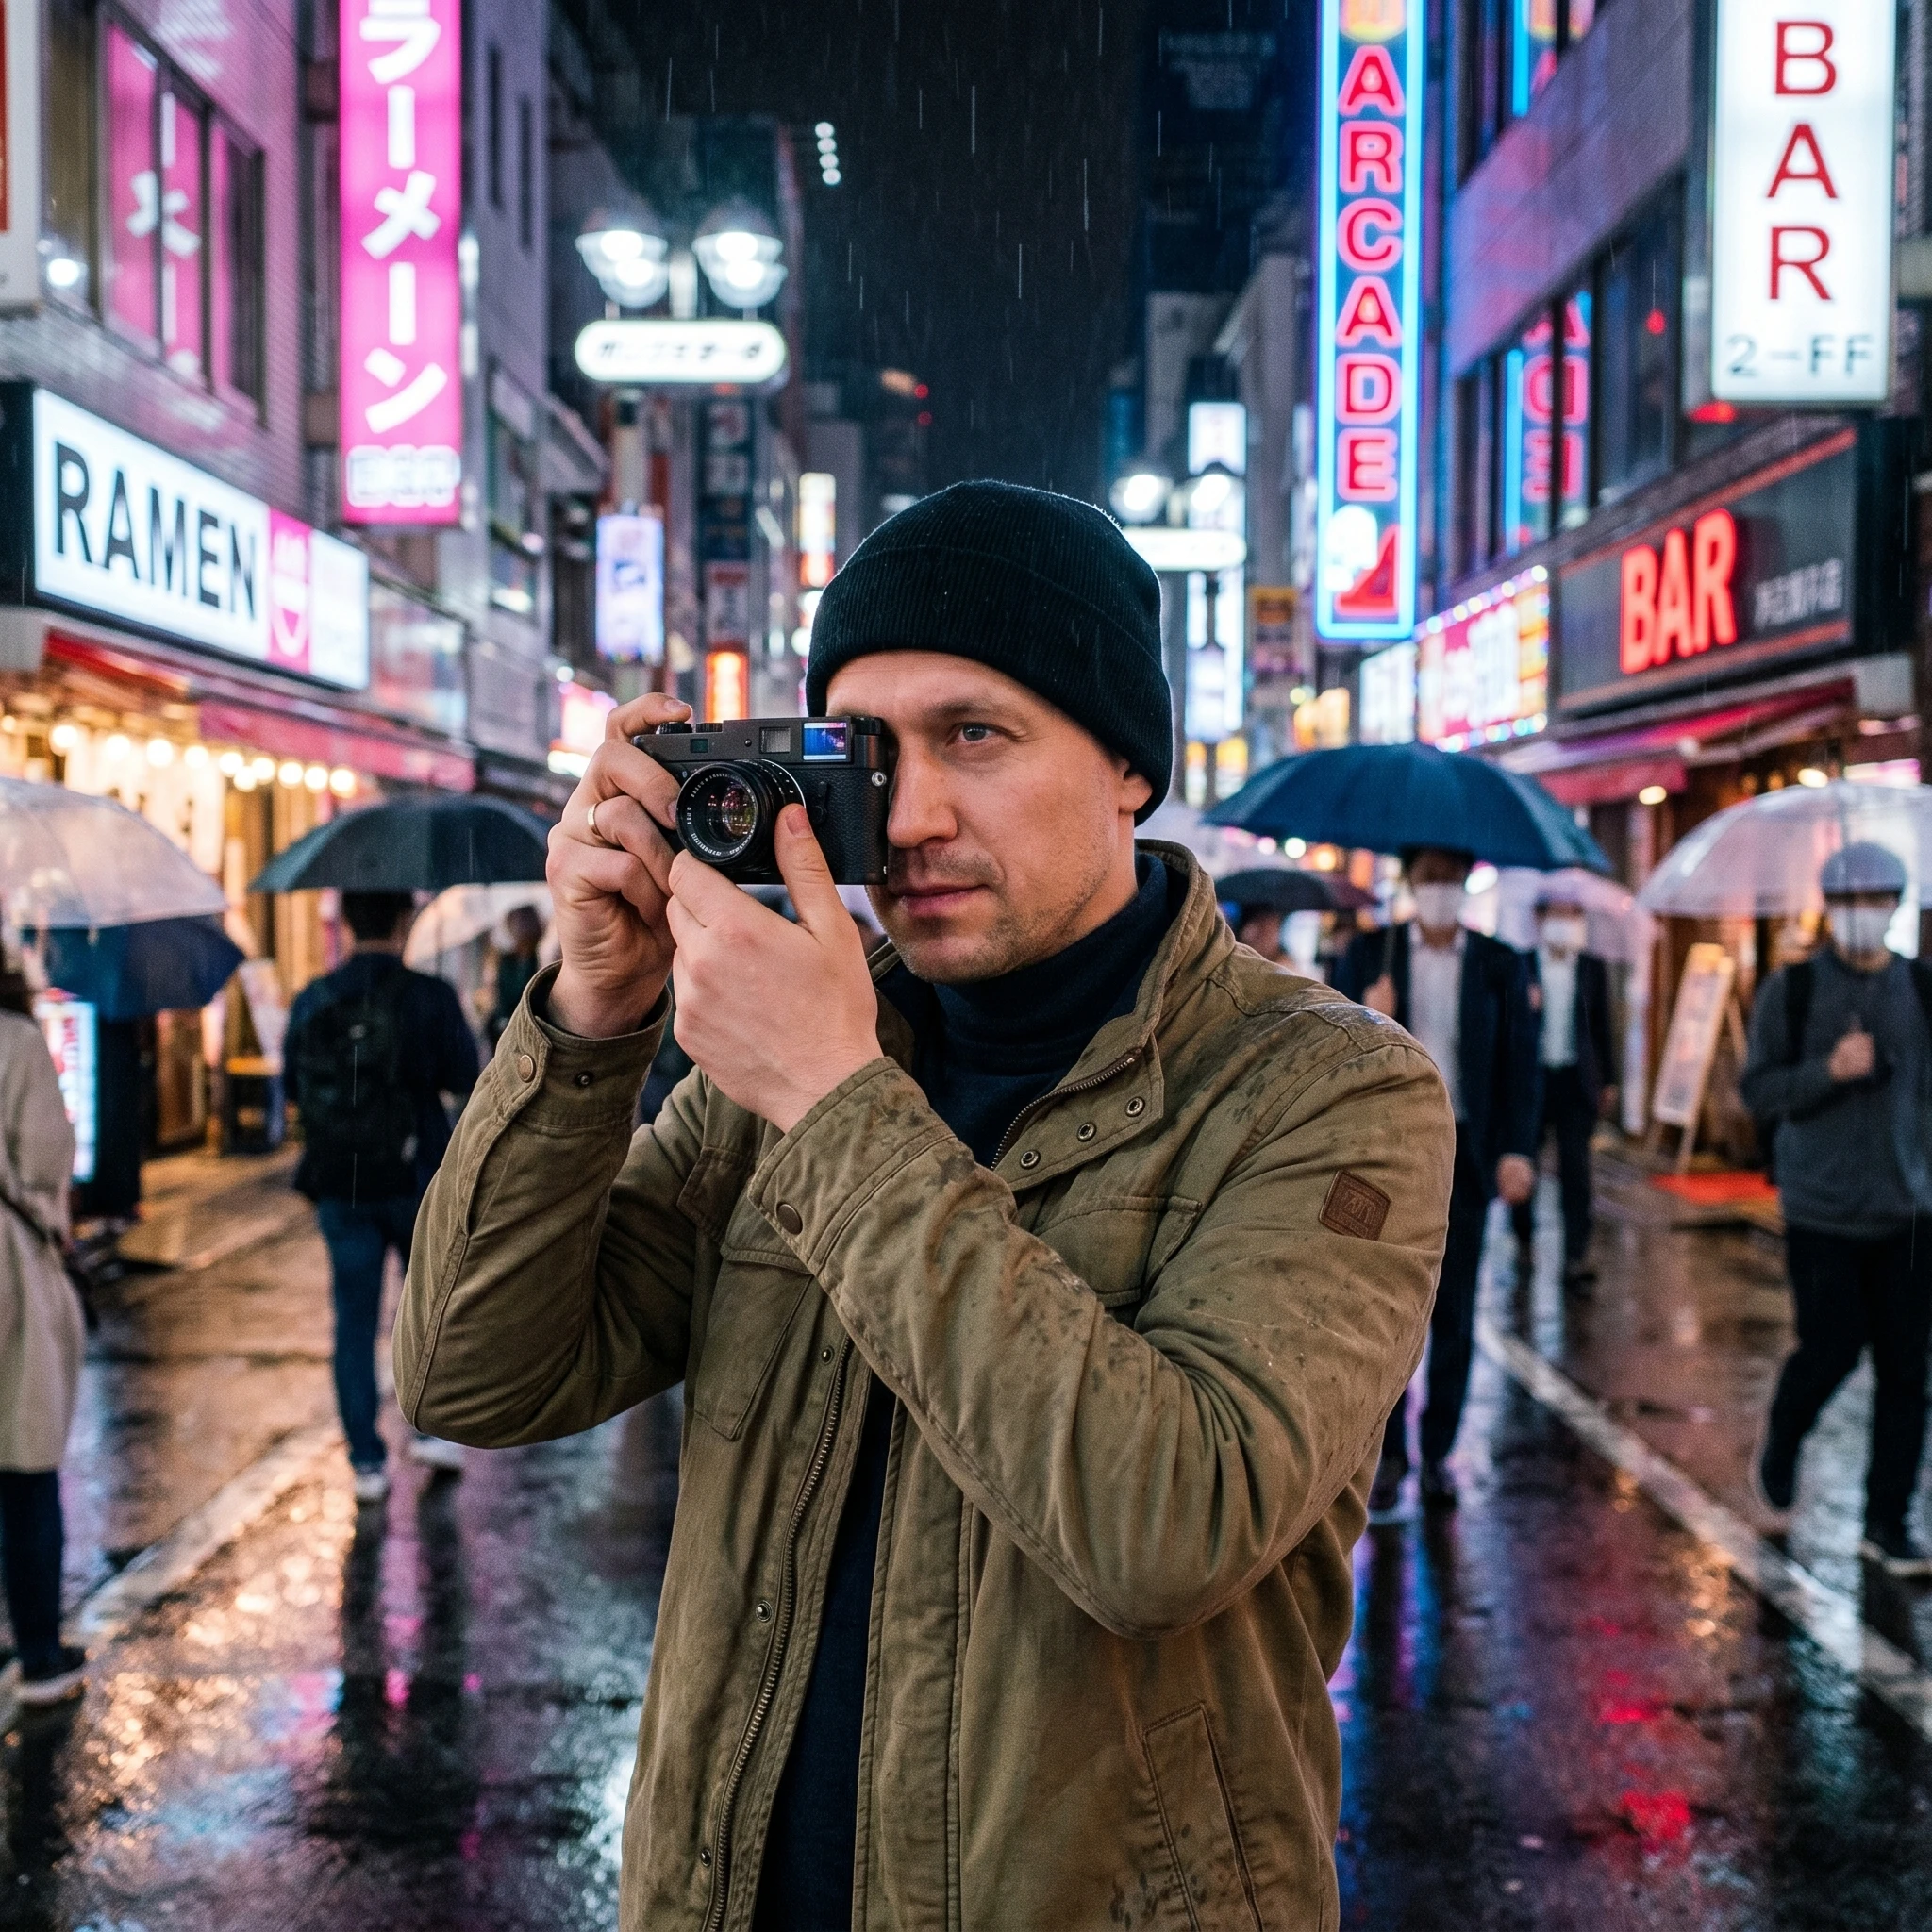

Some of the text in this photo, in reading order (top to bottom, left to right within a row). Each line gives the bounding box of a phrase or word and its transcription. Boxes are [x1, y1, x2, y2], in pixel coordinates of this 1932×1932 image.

[1336, 45, 1406, 501] ARCADE
[1766, 21, 1839, 301] BAR
[55, 440, 257, 620] RAMEN
[1620, 508, 1738, 675] BAR
